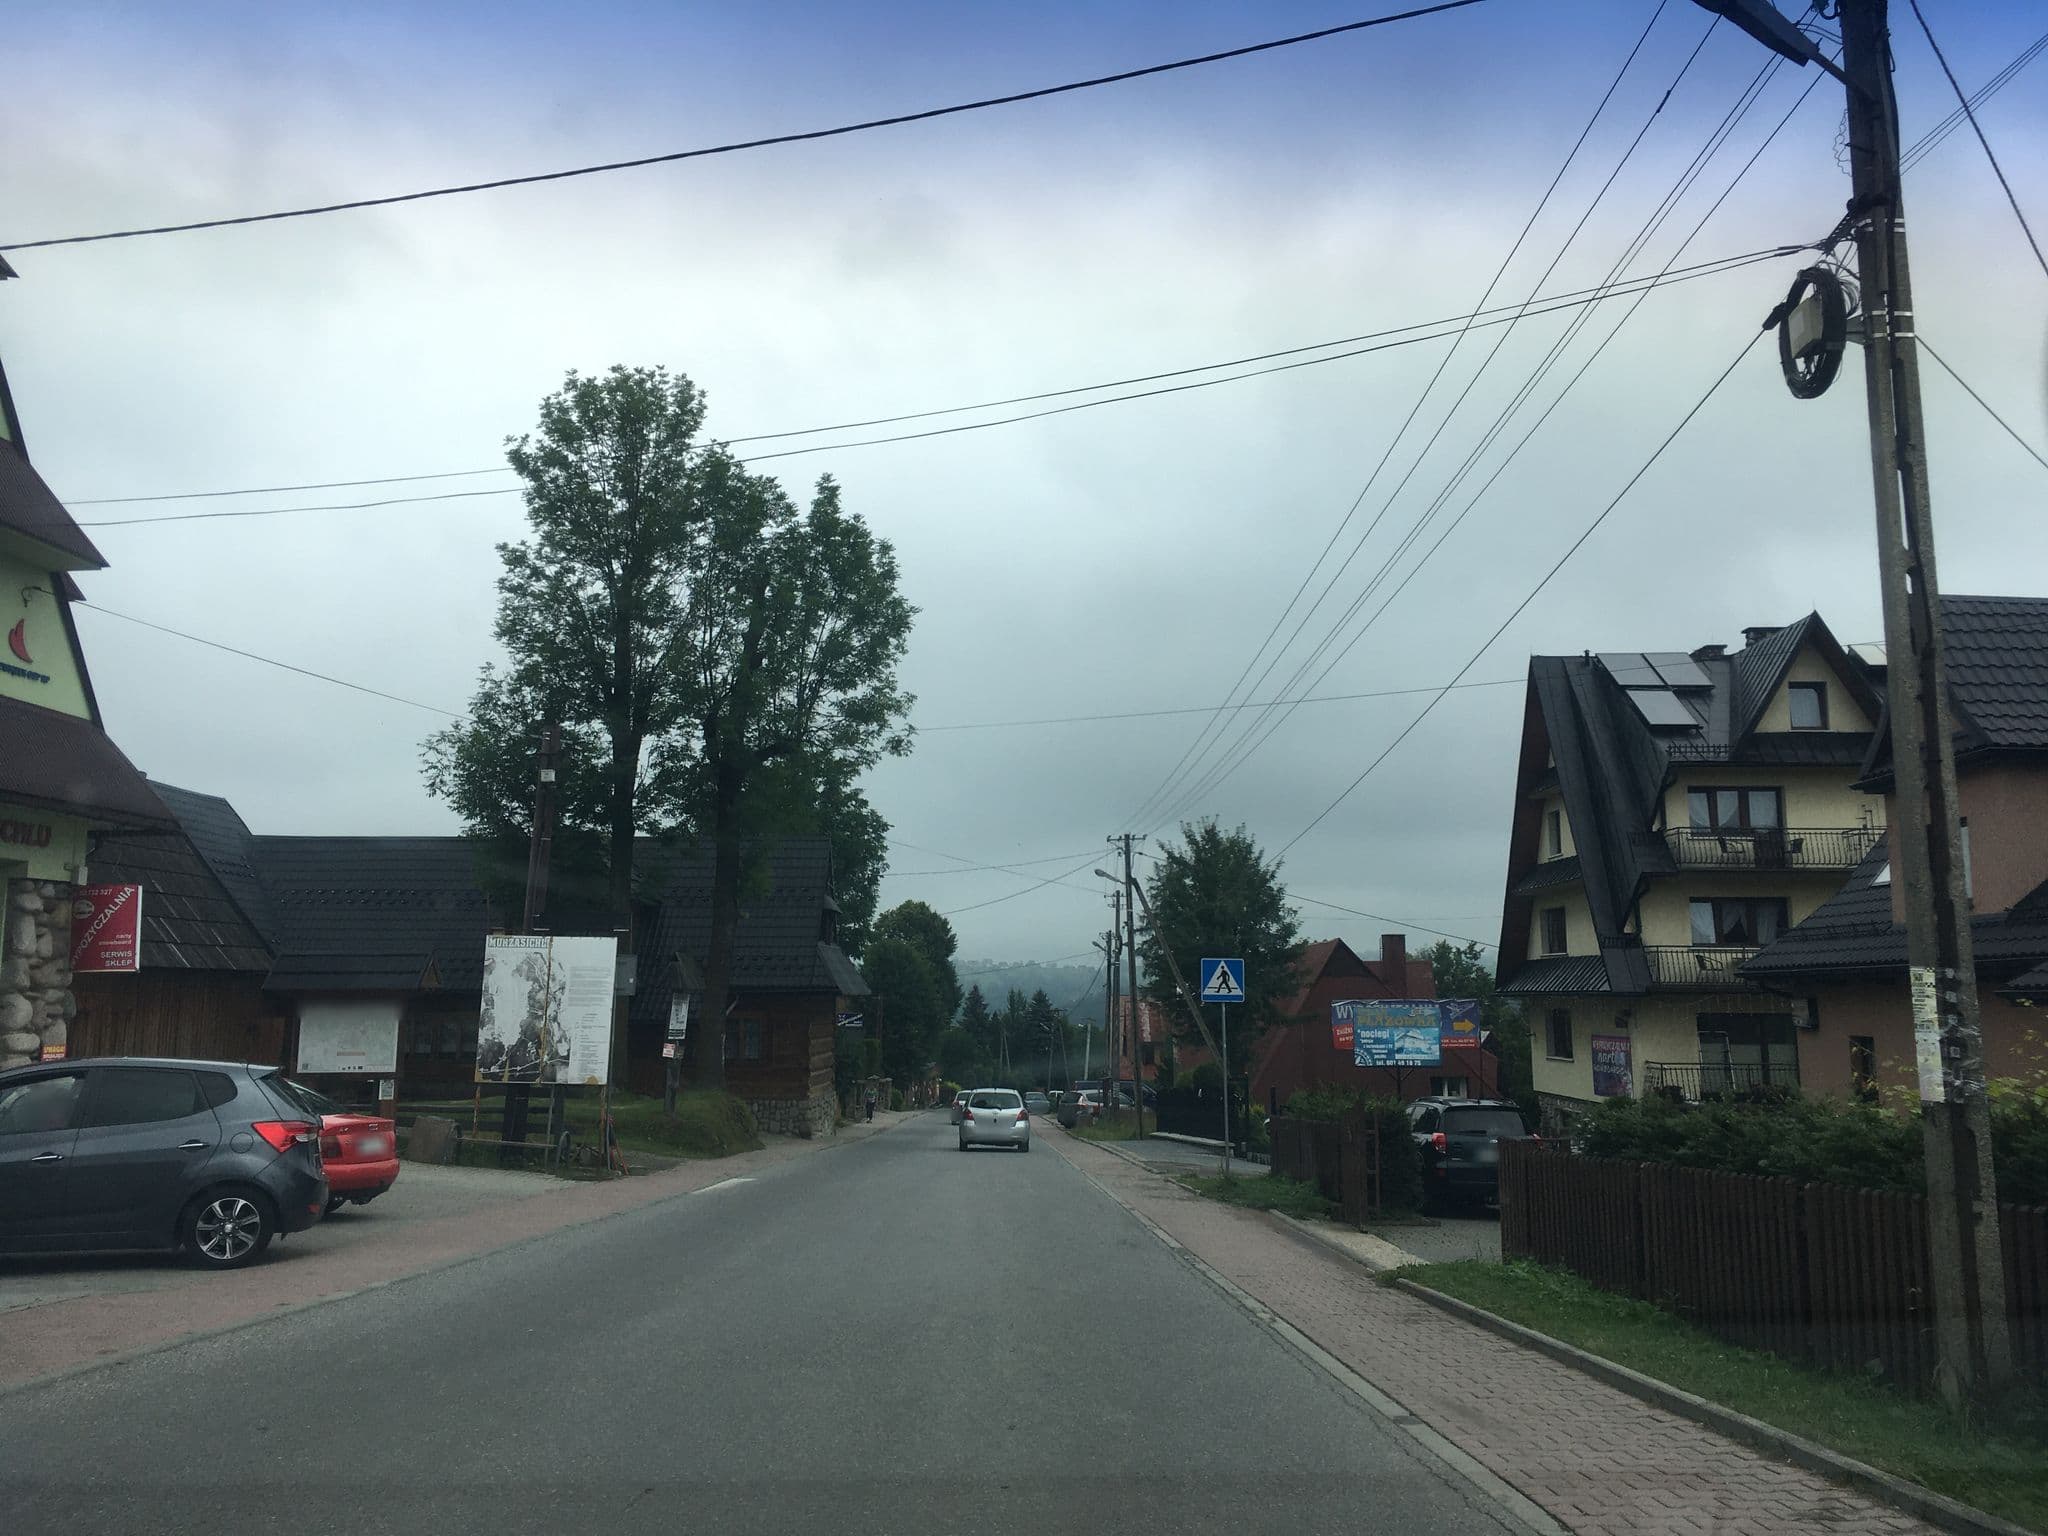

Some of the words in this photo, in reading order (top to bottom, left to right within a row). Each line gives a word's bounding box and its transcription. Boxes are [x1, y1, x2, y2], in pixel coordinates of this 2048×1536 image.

[100, 950, 132, 958] SERWIS
[104, 959, 132, 967] SKLEP
[1361, 1029, 1389, 1039] noclegi
